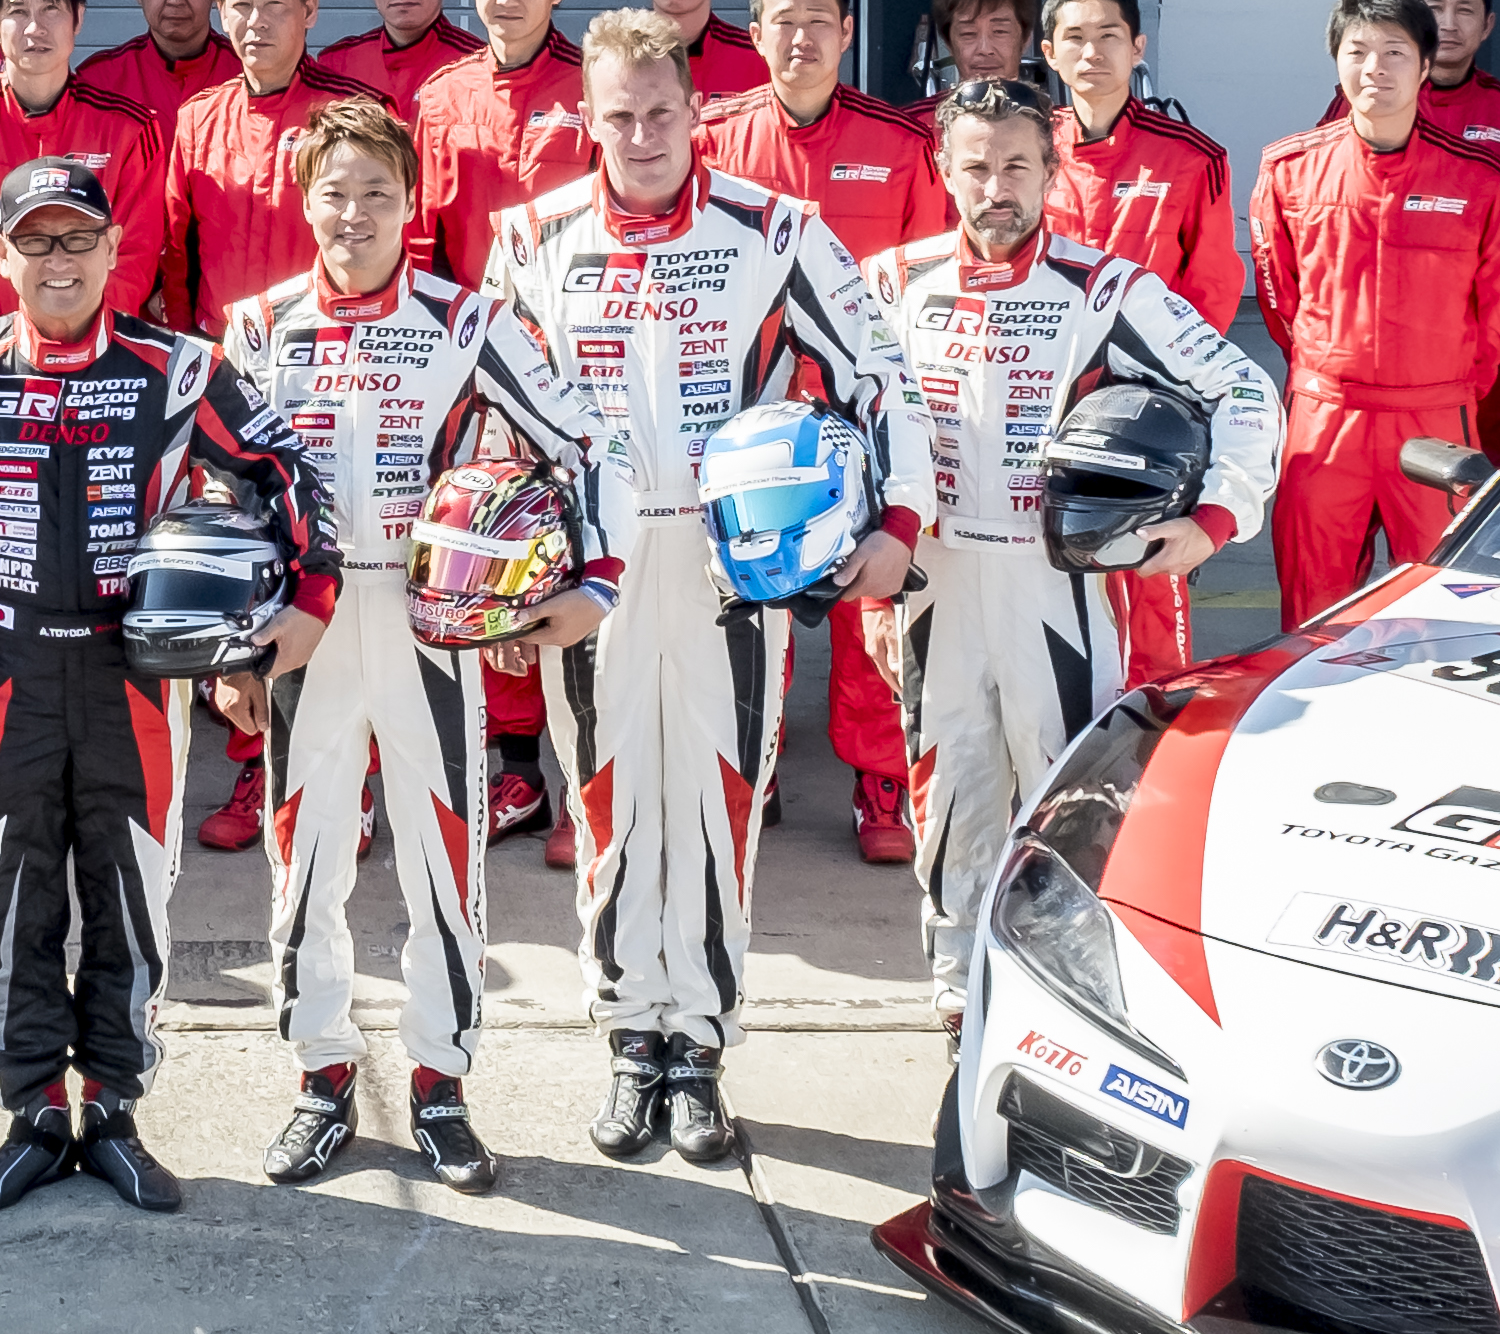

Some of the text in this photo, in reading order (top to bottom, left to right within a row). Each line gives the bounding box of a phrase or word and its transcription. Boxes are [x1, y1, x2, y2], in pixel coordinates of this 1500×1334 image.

[651, 248, 738, 267] TOYOTA
[651, 264, 729, 280] GAZOO
[603, 298, 698, 320] DENSO
[69, 378, 147, 393] TOYOTA
[66, 393, 139, 406] GAZOO
[88, 464, 134, 481] ZENT
[1281, 823, 1414, 855] TOYOTA
[1316, 901, 1447, 962] H&R
